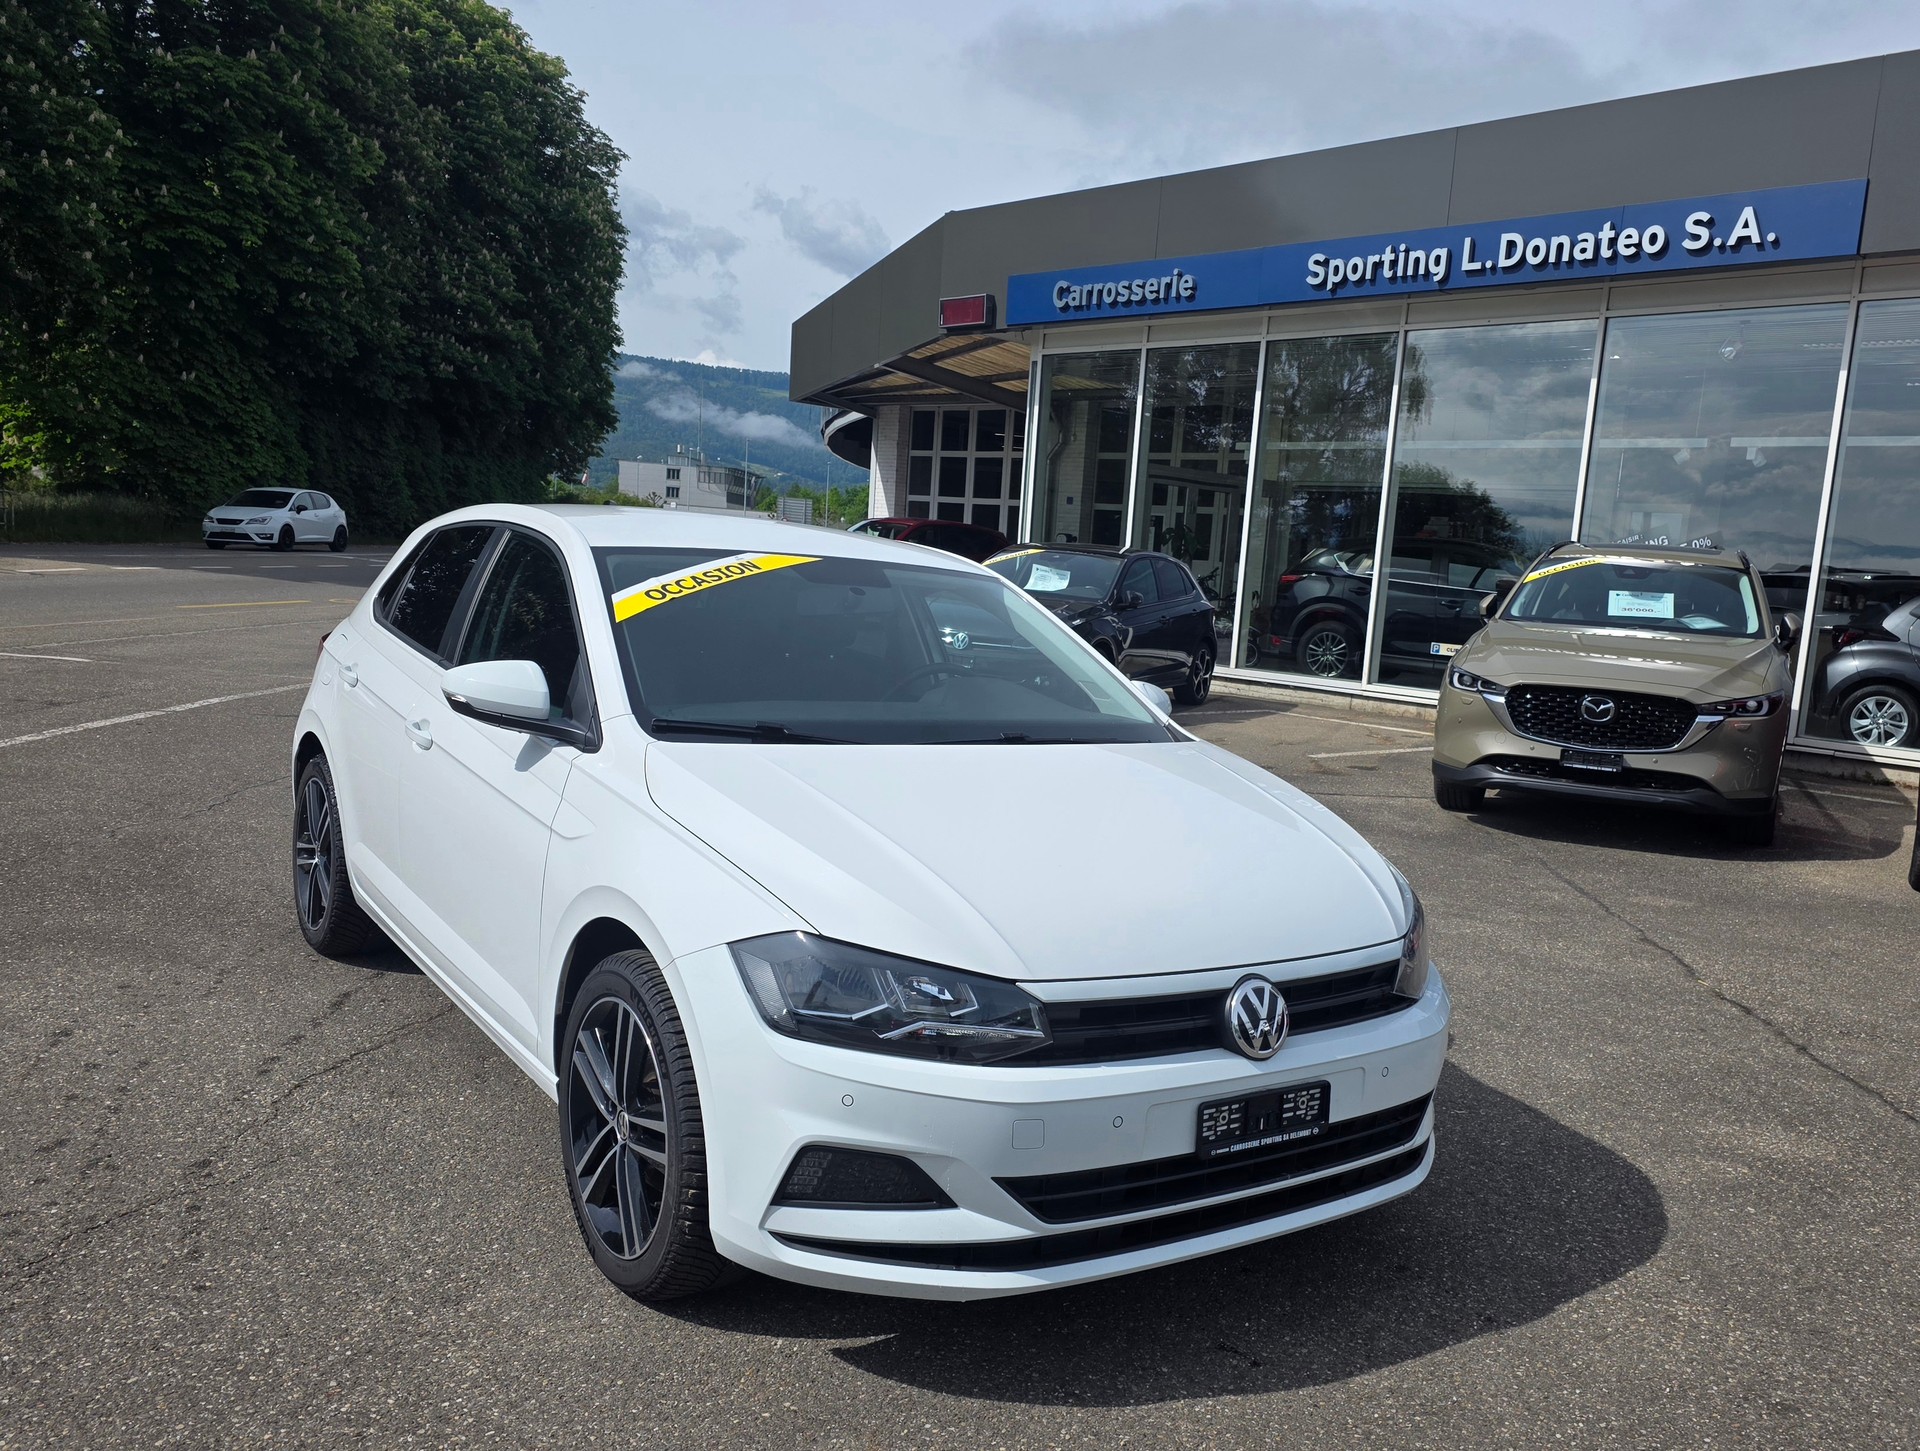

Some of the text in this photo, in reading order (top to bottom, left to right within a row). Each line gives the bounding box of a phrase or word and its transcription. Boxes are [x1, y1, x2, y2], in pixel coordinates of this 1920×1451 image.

[1305, 206, 1778, 291] Sporting L.Donateo S.A.
[1053, 268, 1195, 308] Carrosserie
[644, 560, 761, 601] OCCASION
[1538, 559, 1596, 576] OCCASION
